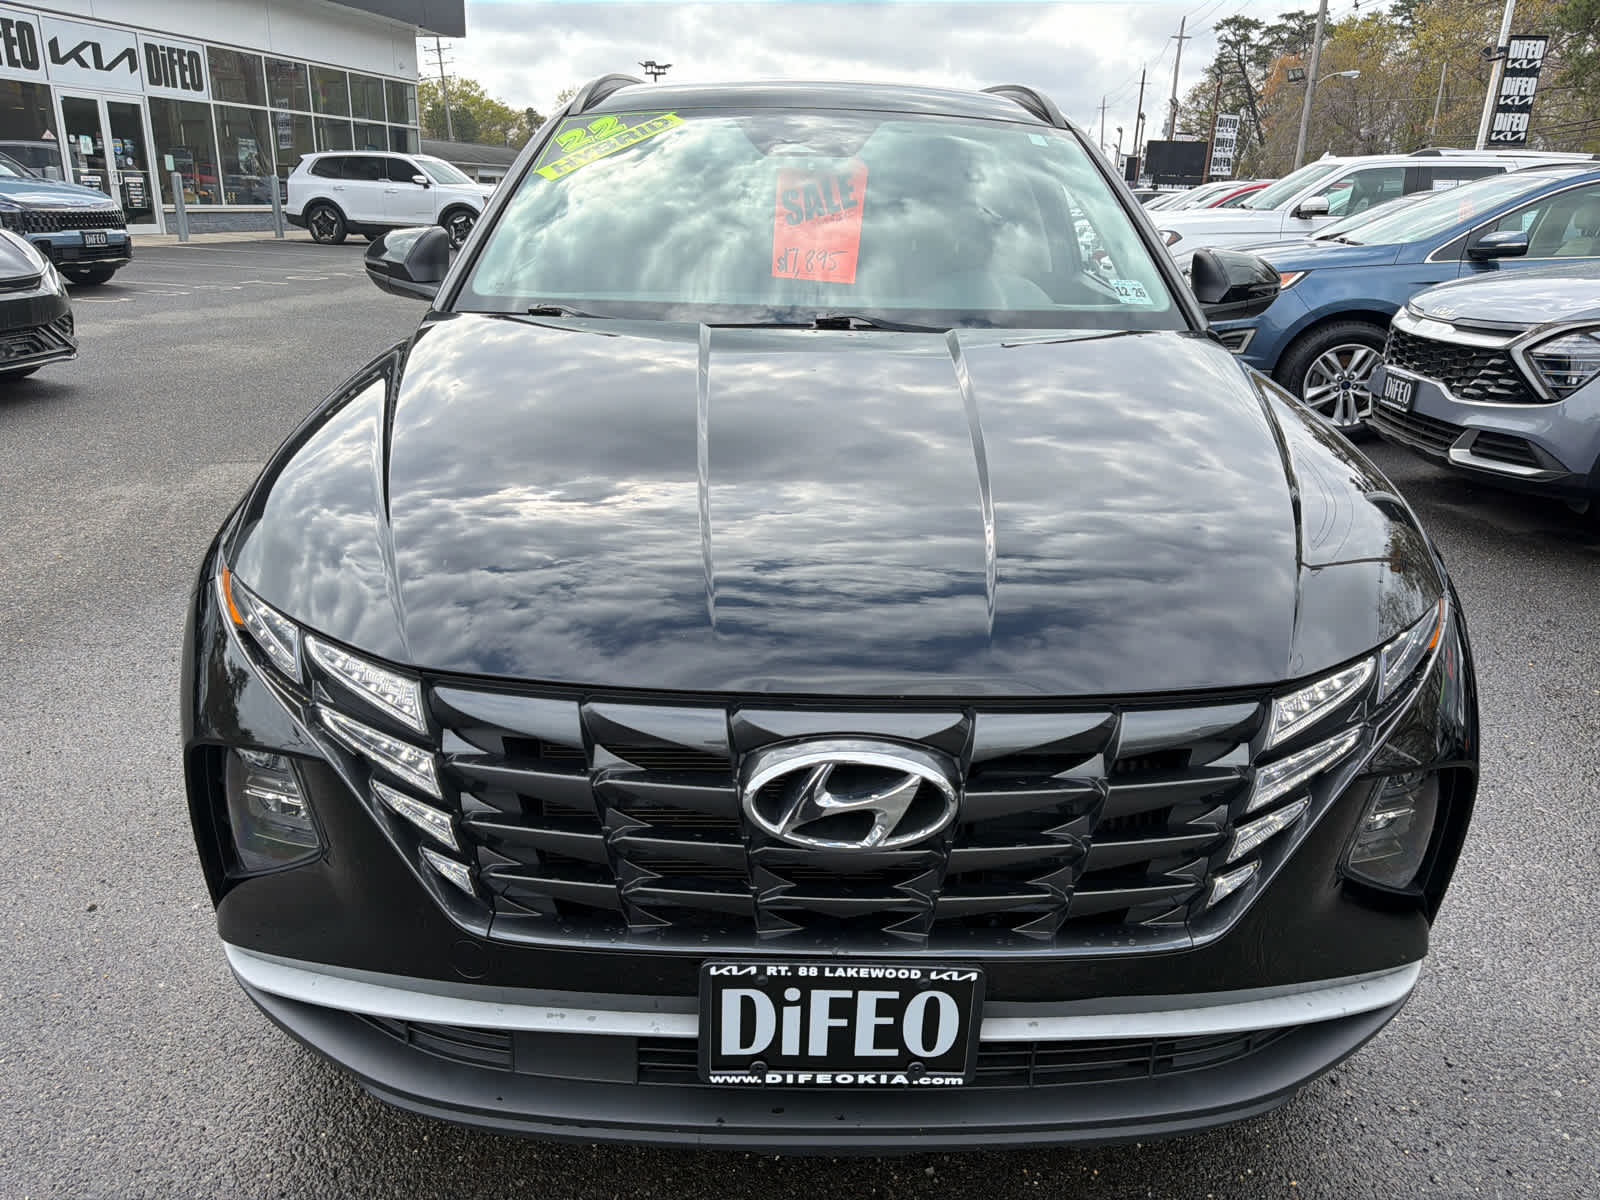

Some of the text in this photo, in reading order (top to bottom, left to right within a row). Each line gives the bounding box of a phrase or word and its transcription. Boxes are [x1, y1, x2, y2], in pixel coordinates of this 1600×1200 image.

[48, 36, 138, 74] KIA
[1508, 39, 1546, 59] DiFEO
[143, 42, 204, 92] DiFEO
[1501, 77, 1538, 95] DiFEO
[555, 116, 628, 152] 22
[1493, 113, 1529, 131] DiFEO
[551, 118, 671, 174] HYBRID
[781, 172, 858, 225] SALE
[1384, 375, 1412, 409] DiFEO
[709, 966, 978, 981] KIA RT. 88 LAKEWOOD KIA
[721, 987, 960, 1058] DiFEO
[709, 1073, 964, 1086] www.DIFEOKIA.com
